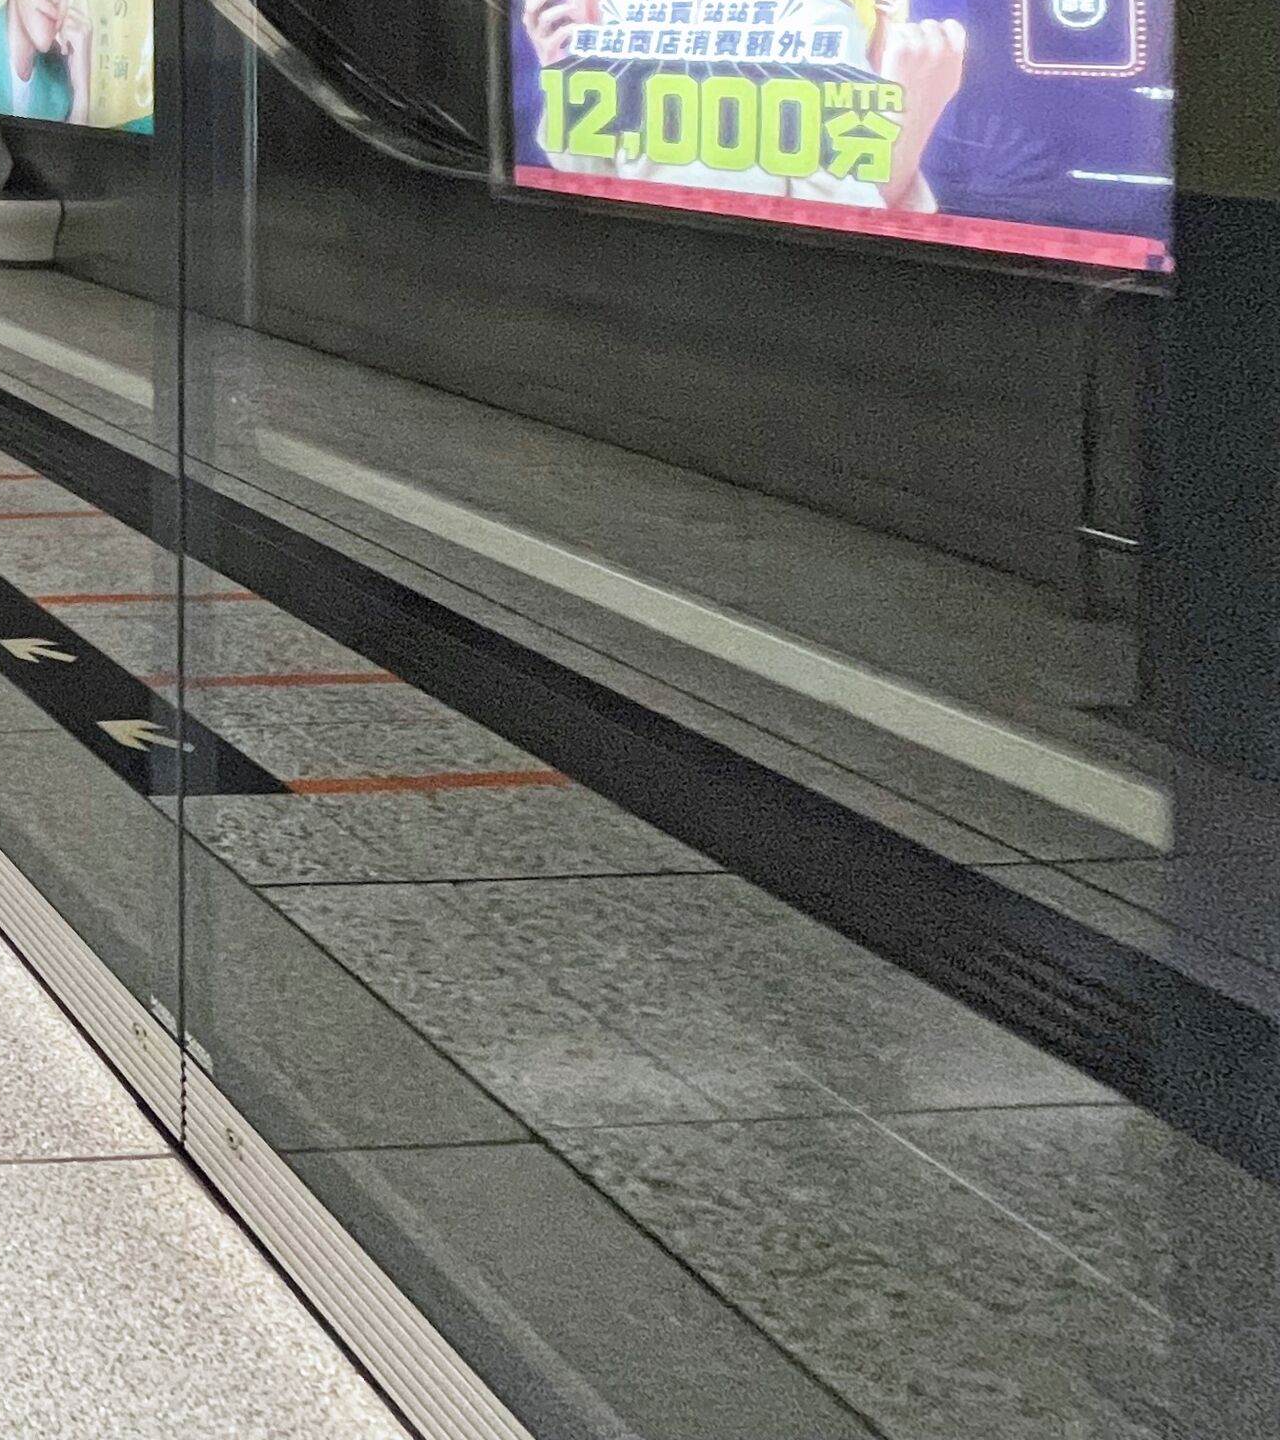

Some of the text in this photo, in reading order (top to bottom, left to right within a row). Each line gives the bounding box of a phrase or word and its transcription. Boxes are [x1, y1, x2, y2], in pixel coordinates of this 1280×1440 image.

[541, 70, 903, 184] 12,000 MTR 分
